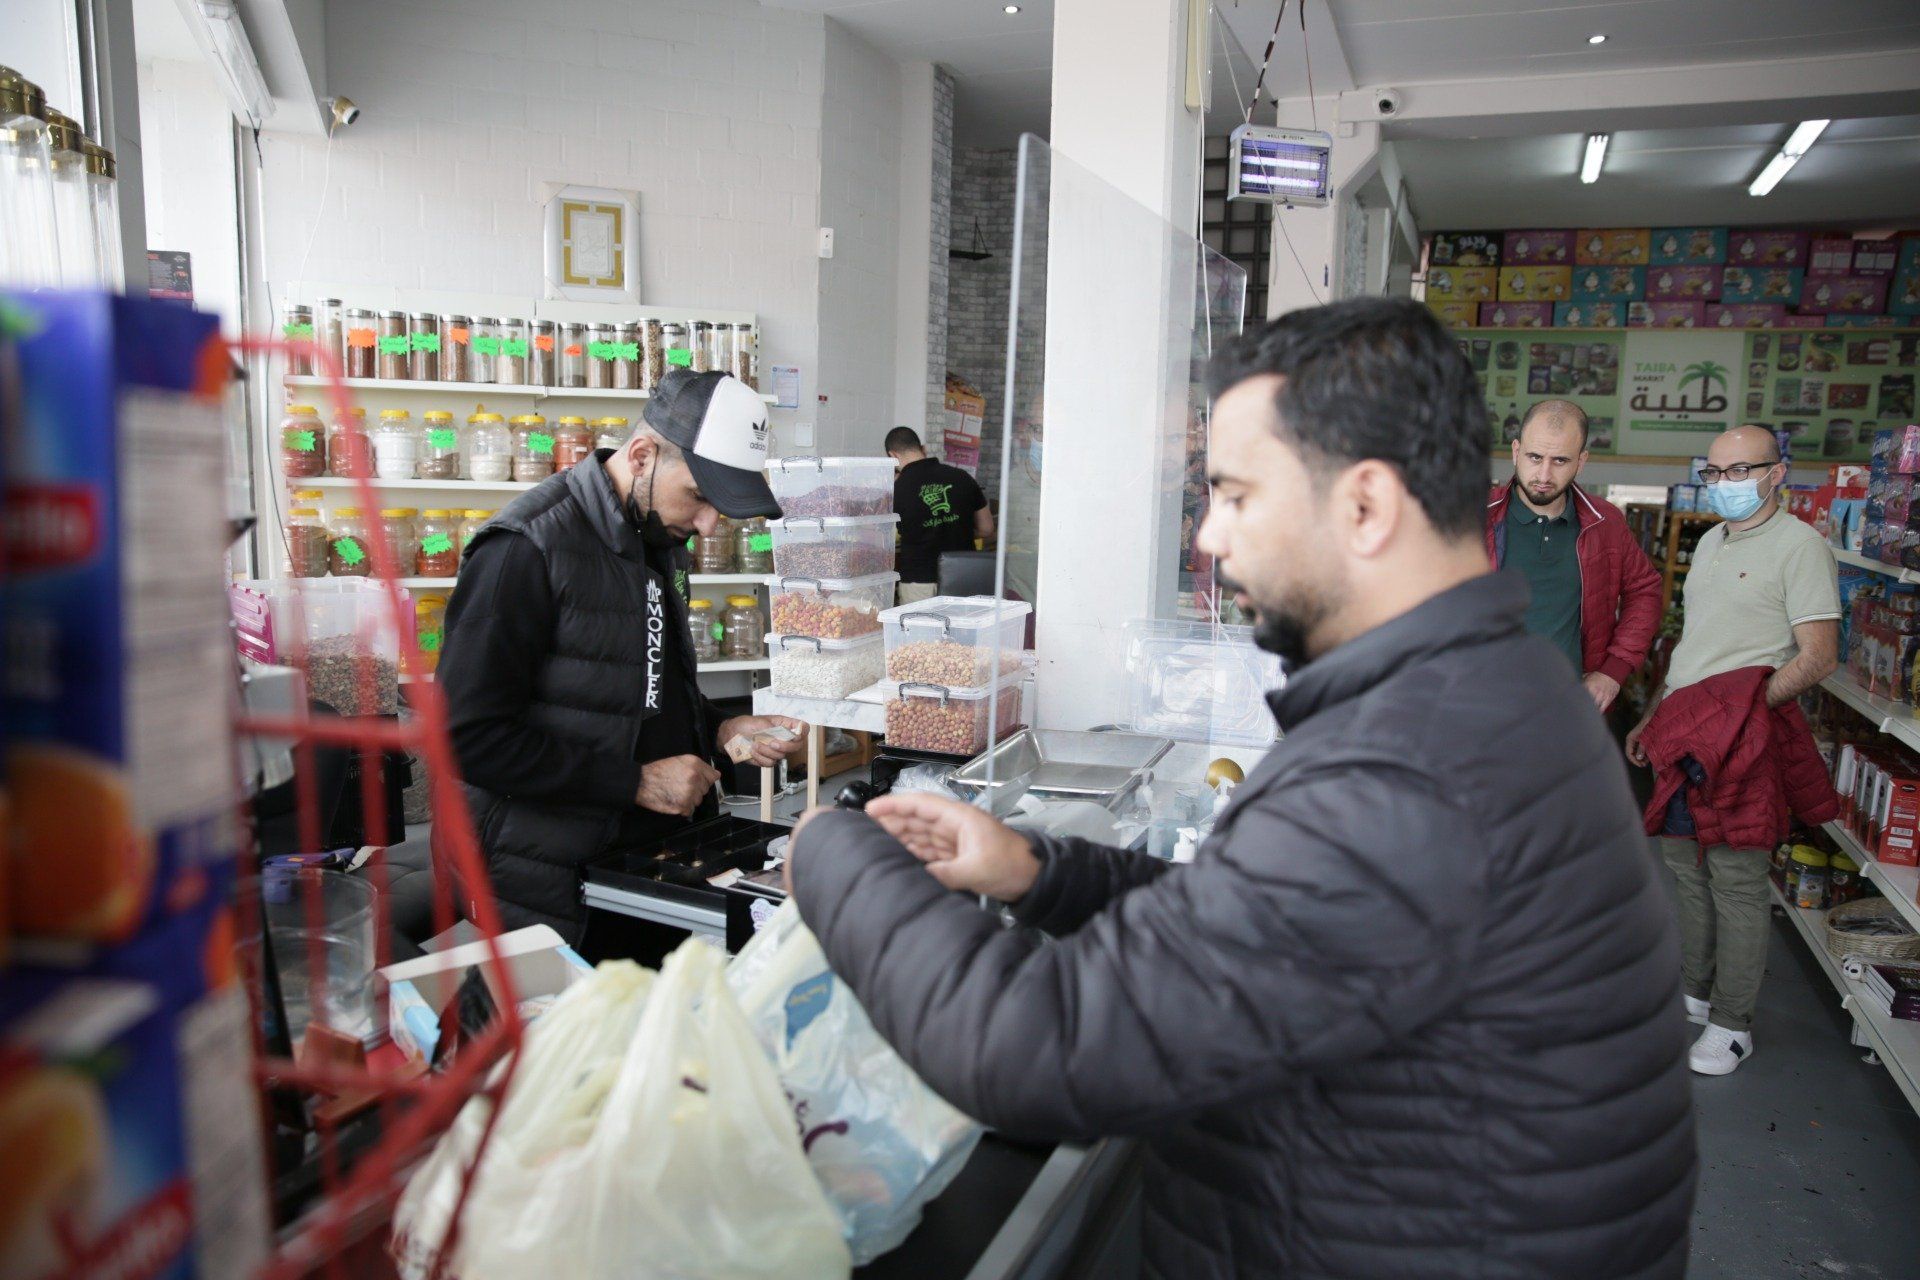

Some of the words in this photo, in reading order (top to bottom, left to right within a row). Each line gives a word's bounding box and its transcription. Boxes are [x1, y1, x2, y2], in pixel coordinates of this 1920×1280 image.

[1634, 362, 1676, 373] TAIBA
[1630, 375, 1728, 419] طيبة
[645, 601, 664, 709] MONCLER
